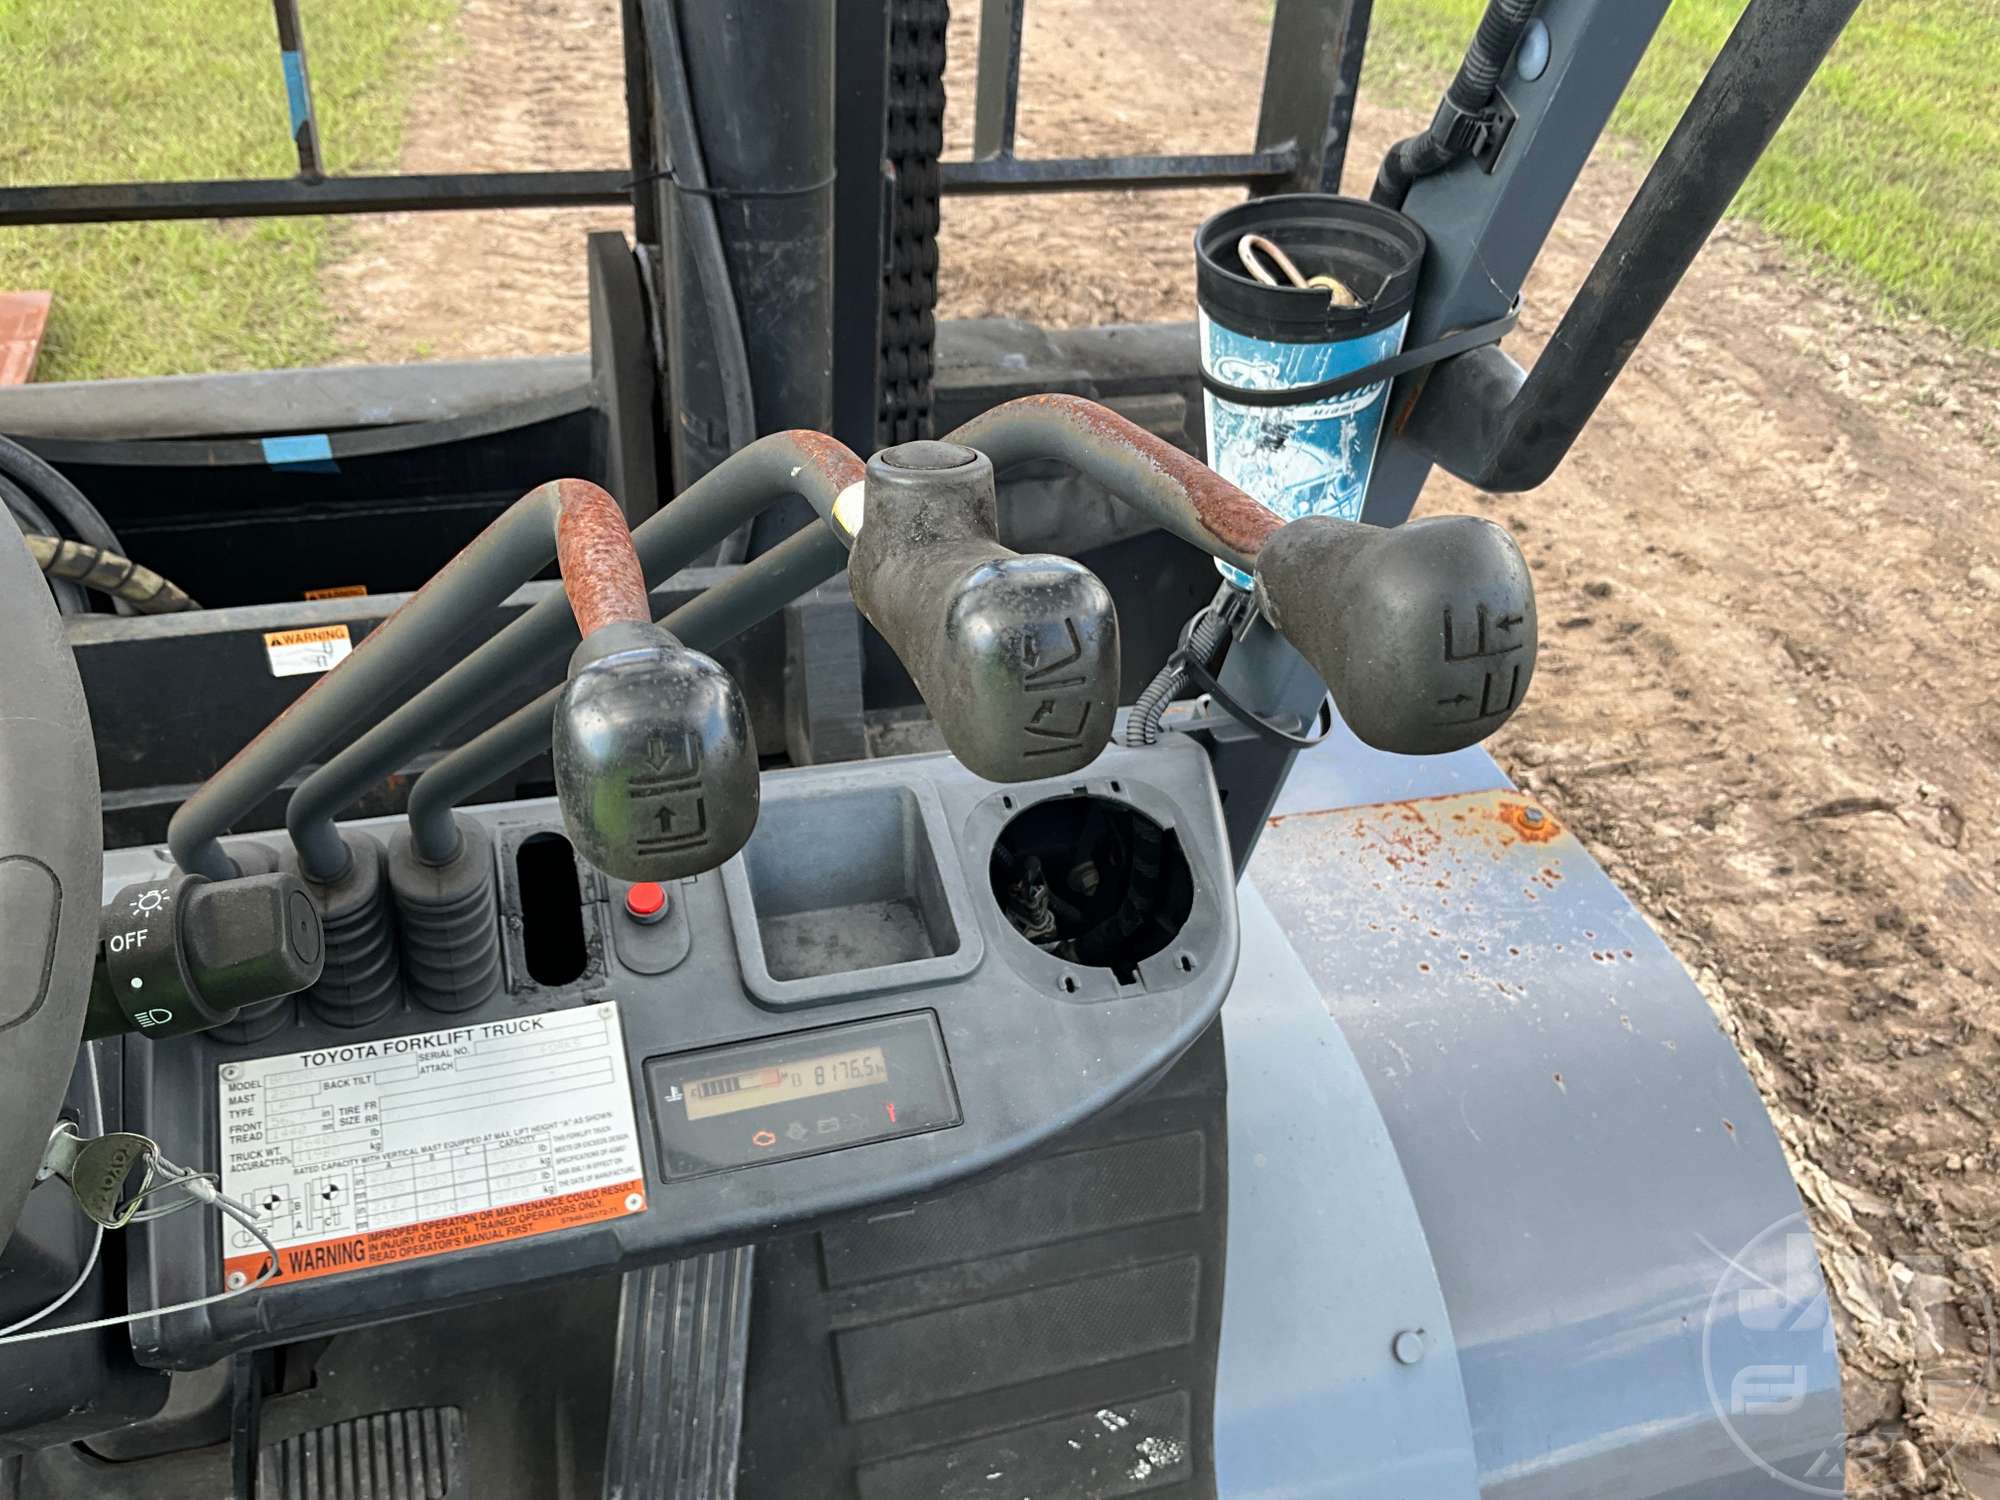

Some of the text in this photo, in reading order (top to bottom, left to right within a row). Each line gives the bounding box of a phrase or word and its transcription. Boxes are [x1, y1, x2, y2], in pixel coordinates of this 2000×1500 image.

[283, 628, 345, 645] WARNING
[110, 929, 149, 953] OFF
[301, 1017, 544, 1068] TOYOTA FORKLIFT TRUCK
[418, 1051, 452, 1062] SERIAL
[420, 1063, 453, 1075] ATTACH
[813, 1055, 874, 1087] 8176.5
[228, 1080, 262, 1092] MODEL
[323, 1080, 351, 1091] BACK
[353, 1075, 372, 1086] TILT
[228, 1093, 256, 1105] MAST
[228, 1106, 254, 1119] TYPE
[339, 1100, 377, 1116] TIRE FR
[229, 1120, 263, 1134] FRONT
[339, 1113, 379, 1127] SIZE RR
[229, 1131, 263, 1145] TREAD
[370, 1127, 380, 1137] lb
[293, 1165, 320, 1176] RATED
[320, 1158, 358, 1172] CAPACITY
[361, 1154, 381, 1164] WITH
[382, 1148, 419, 1161] VERTICAL
[420, 1142, 442, 1154] MAST
[443, 1135, 482, 1150] EQUIPPED
[483, 1132, 492, 1142] AT
[513, 1126, 530, 1137] LIFT
[531, 1121, 559, 1133] HEIGHT
[573, 1116, 583, 1125] AS
[370, 1141, 381, 1153] kg
[499, 1135, 537, 1150] CAPACITY
[230, 1149, 264, 1163] TRUCK
[367, 1181, 636, 1242] IMPROPER OPERATION OR MAINTENANCE COULD RESULT
[368, 1242, 378, 1252] IN
[381, 1236, 415, 1249] INJURY
[418, 1232, 433, 1243] OR
[475, 1215, 517, 1232] TRAINED
[518, 1204, 577, 1222] OPERATORS
[369, 1250, 397, 1264] READ
[399, 1237, 461, 1257] OPERATOR'S
[463, 1227, 505, 1244] MANUAL
[288, 1240, 366, 1275] WARNING
